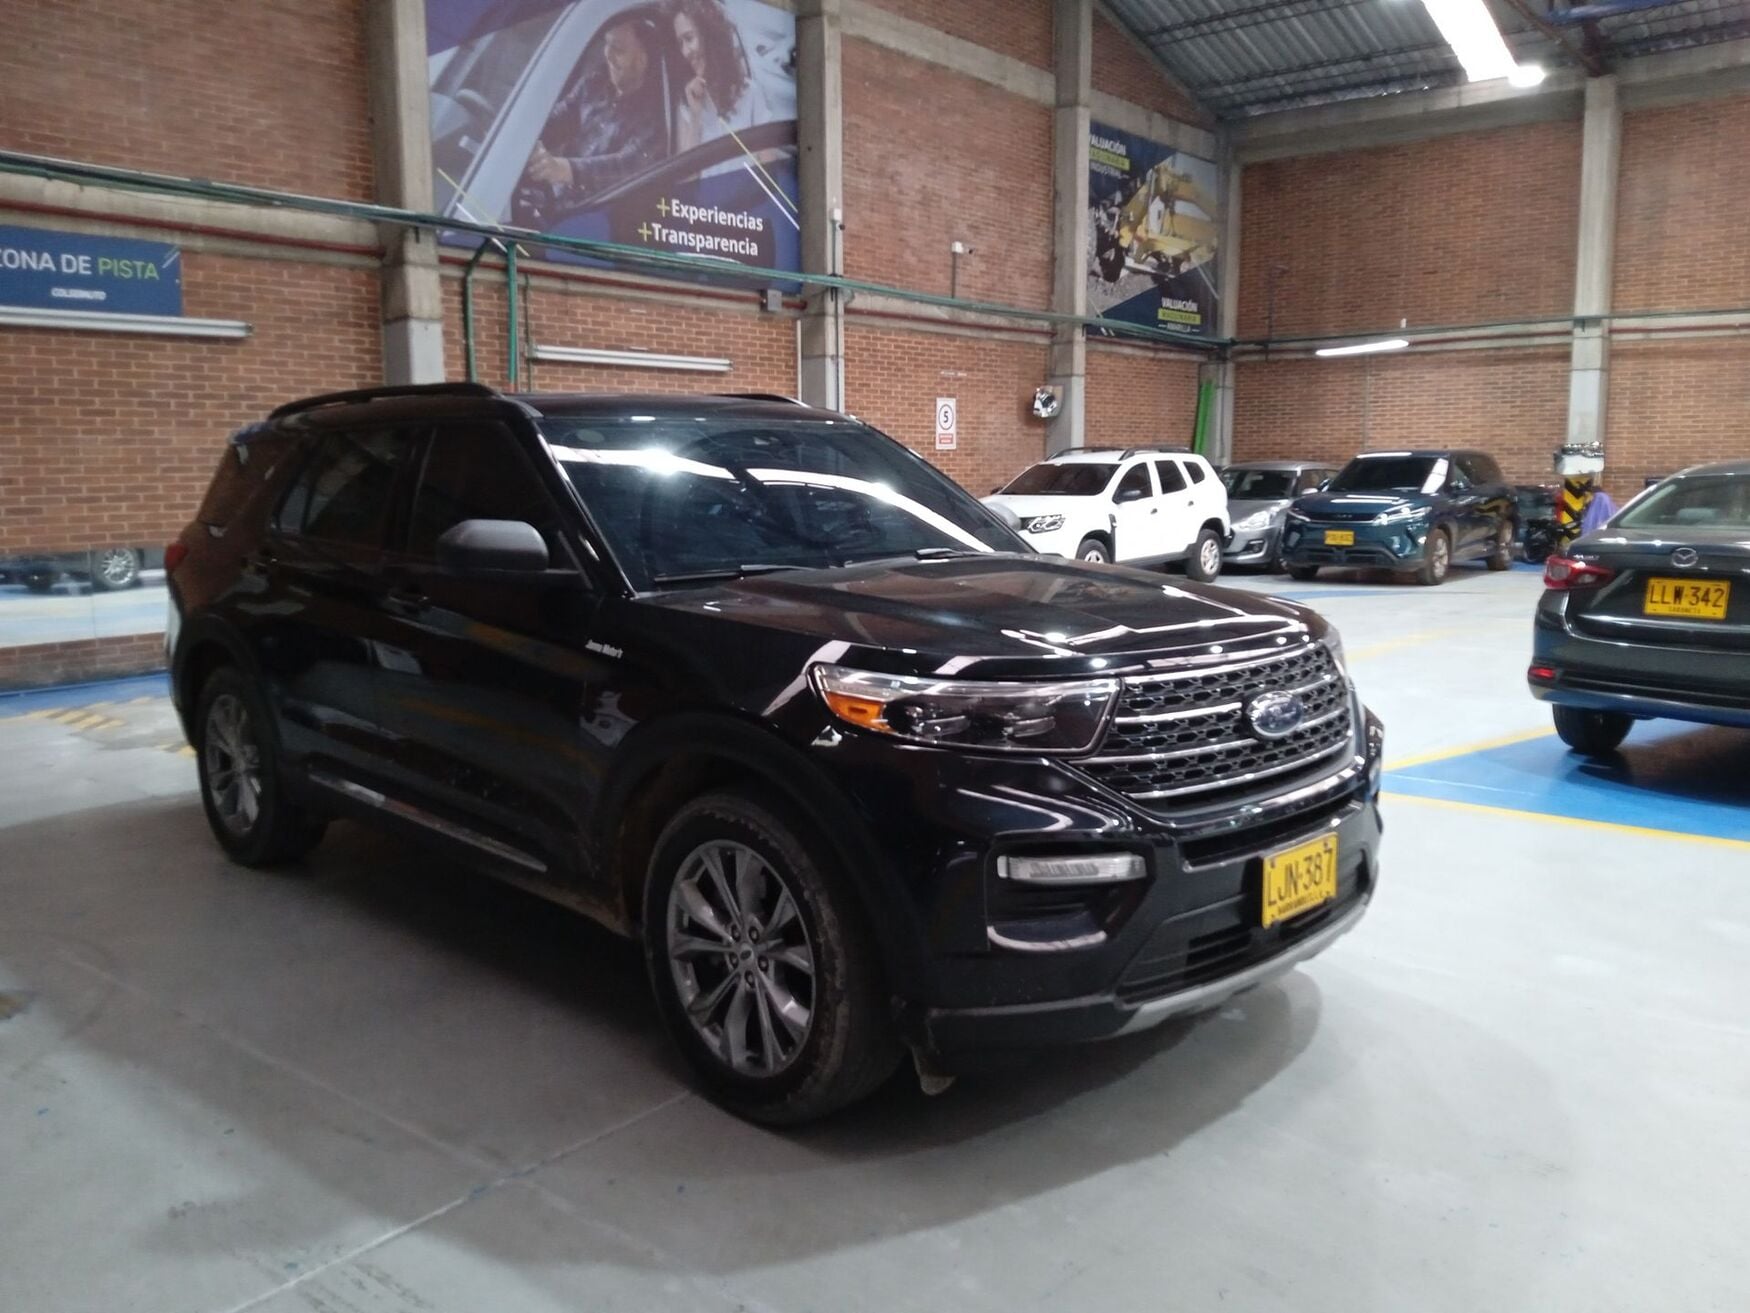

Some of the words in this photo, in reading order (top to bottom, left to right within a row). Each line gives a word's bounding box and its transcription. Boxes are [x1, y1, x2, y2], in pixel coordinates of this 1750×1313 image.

[0, 248, 56, 271] ONA
[60, 254, 92, 275] DE
[97, 256, 159, 280] PISTA
[943, 410, 949, 424] 5
